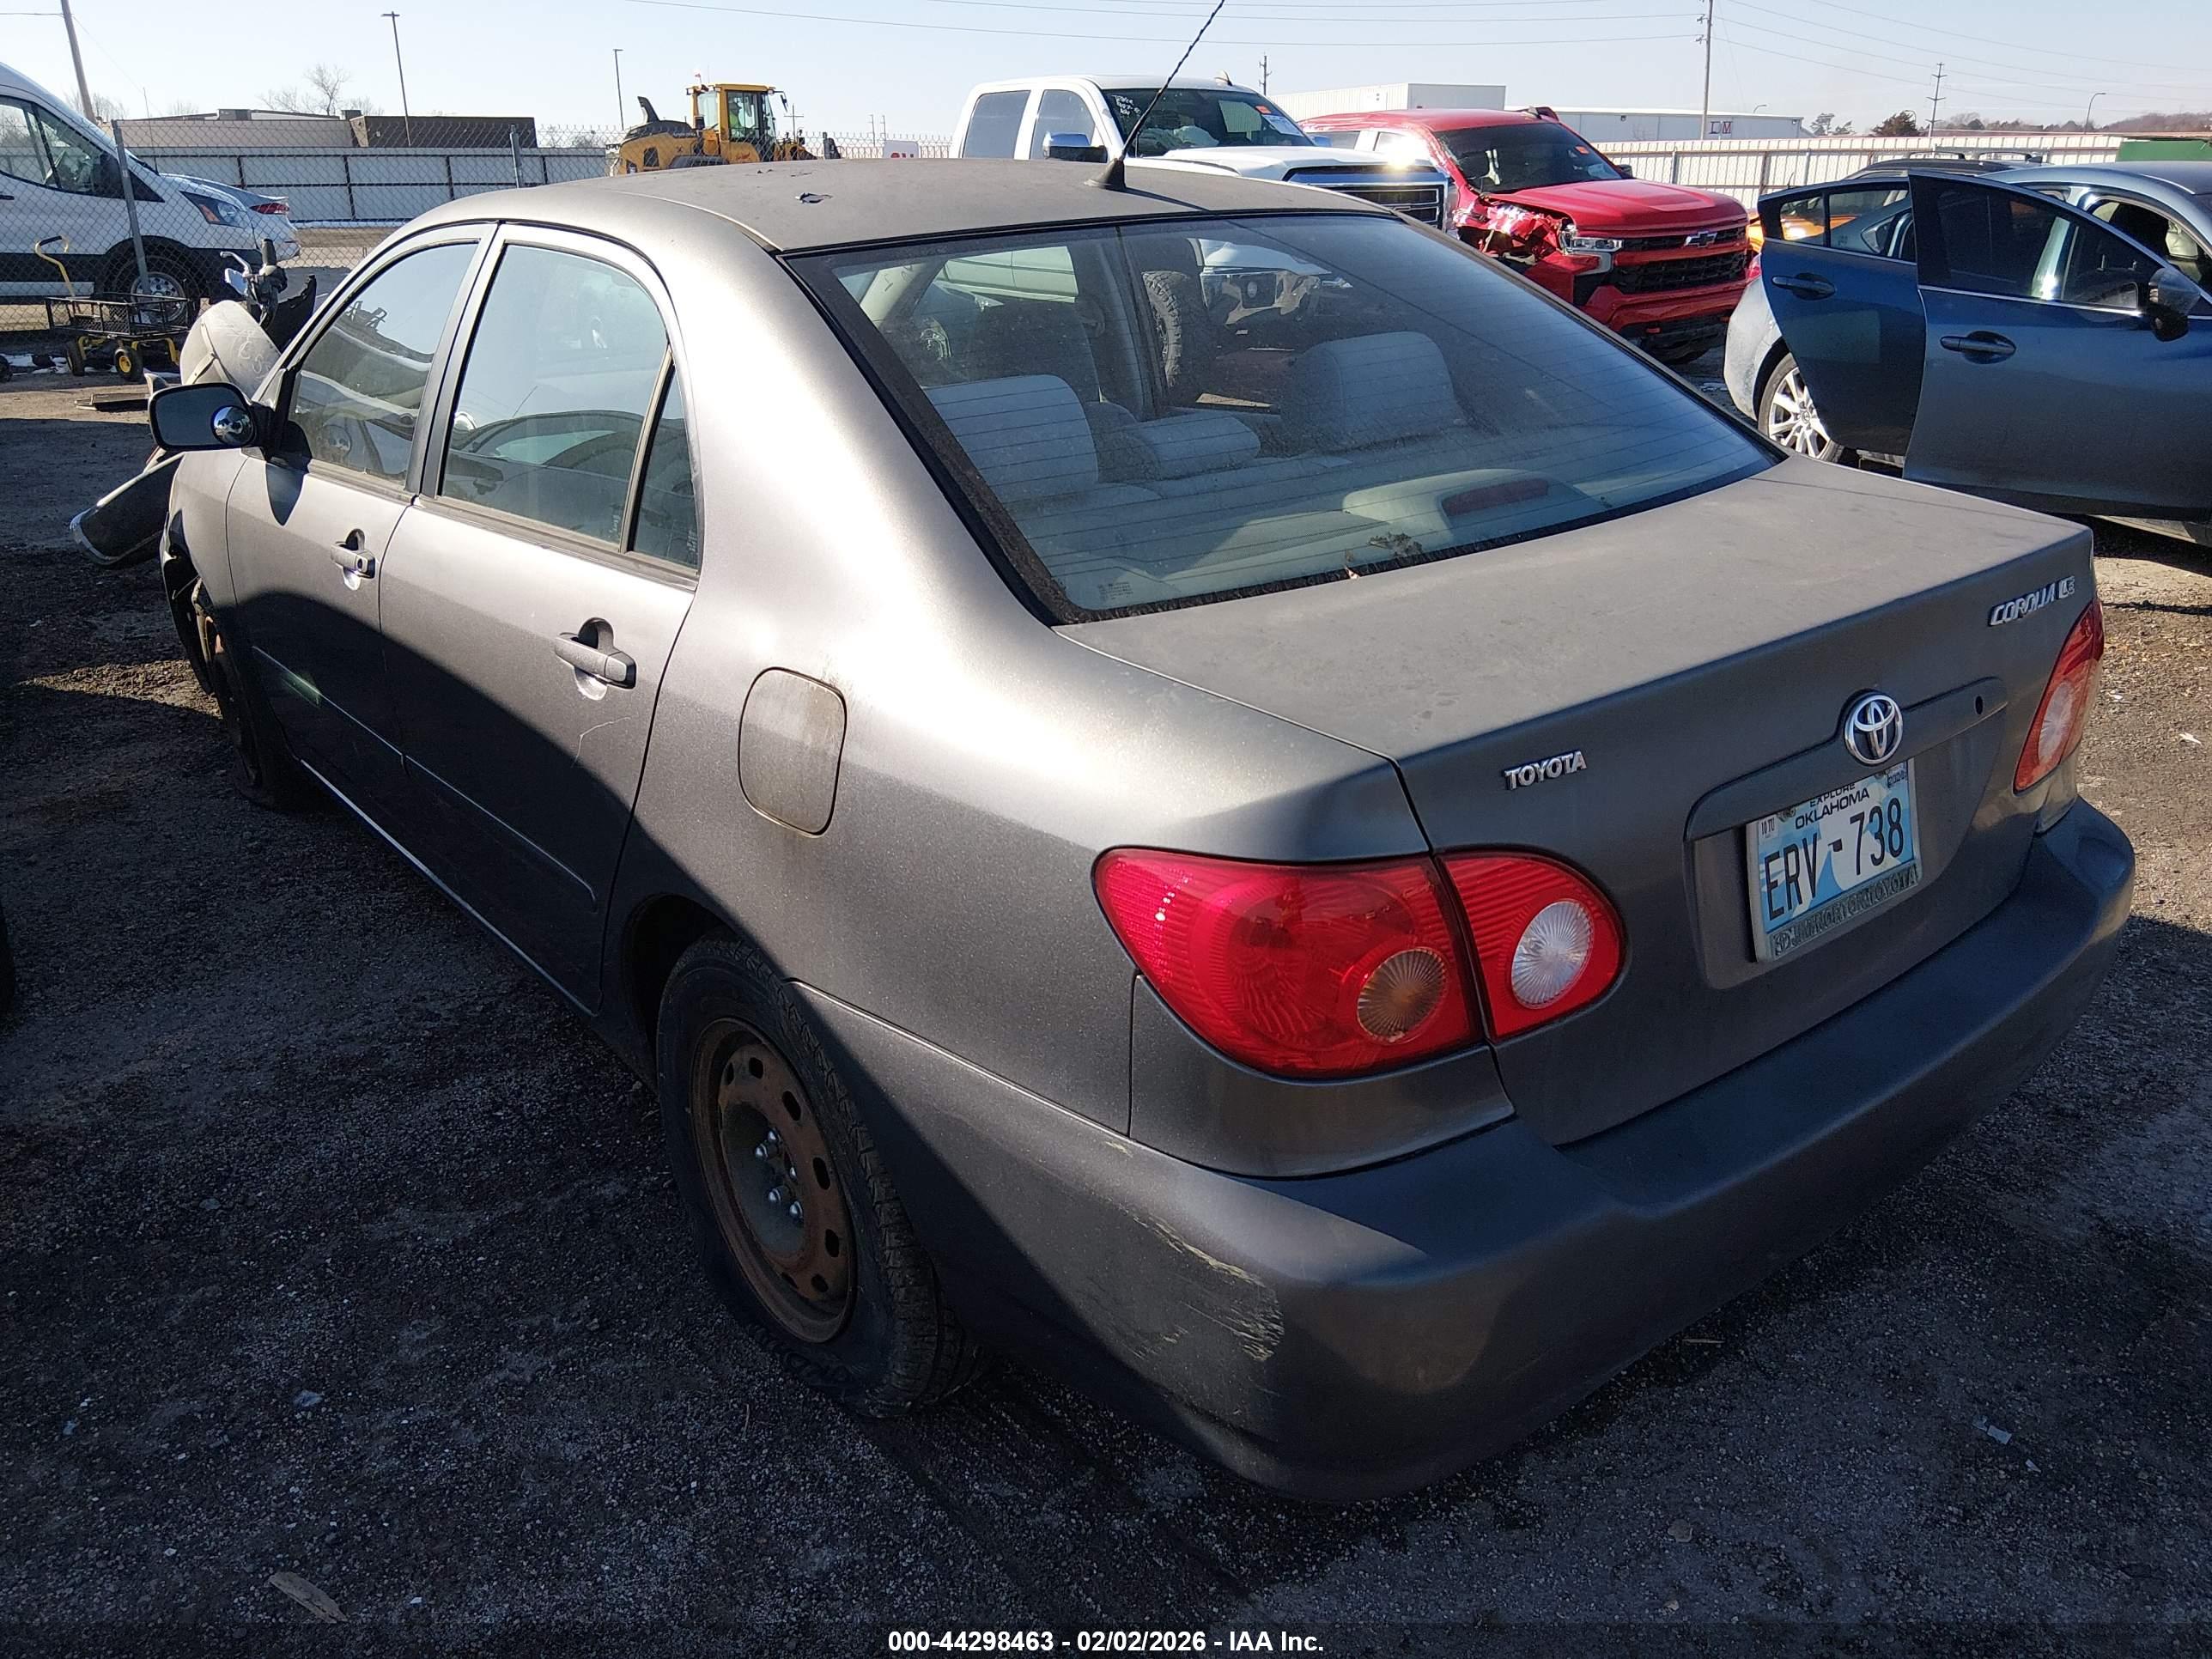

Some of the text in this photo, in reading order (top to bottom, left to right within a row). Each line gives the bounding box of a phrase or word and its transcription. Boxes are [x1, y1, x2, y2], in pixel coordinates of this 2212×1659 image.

[1990, 583, 2056, 626] COROLLA
[1504, 750, 1588, 790] TOYOTA
[1795, 787, 1870, 830] OKLAHOMA
